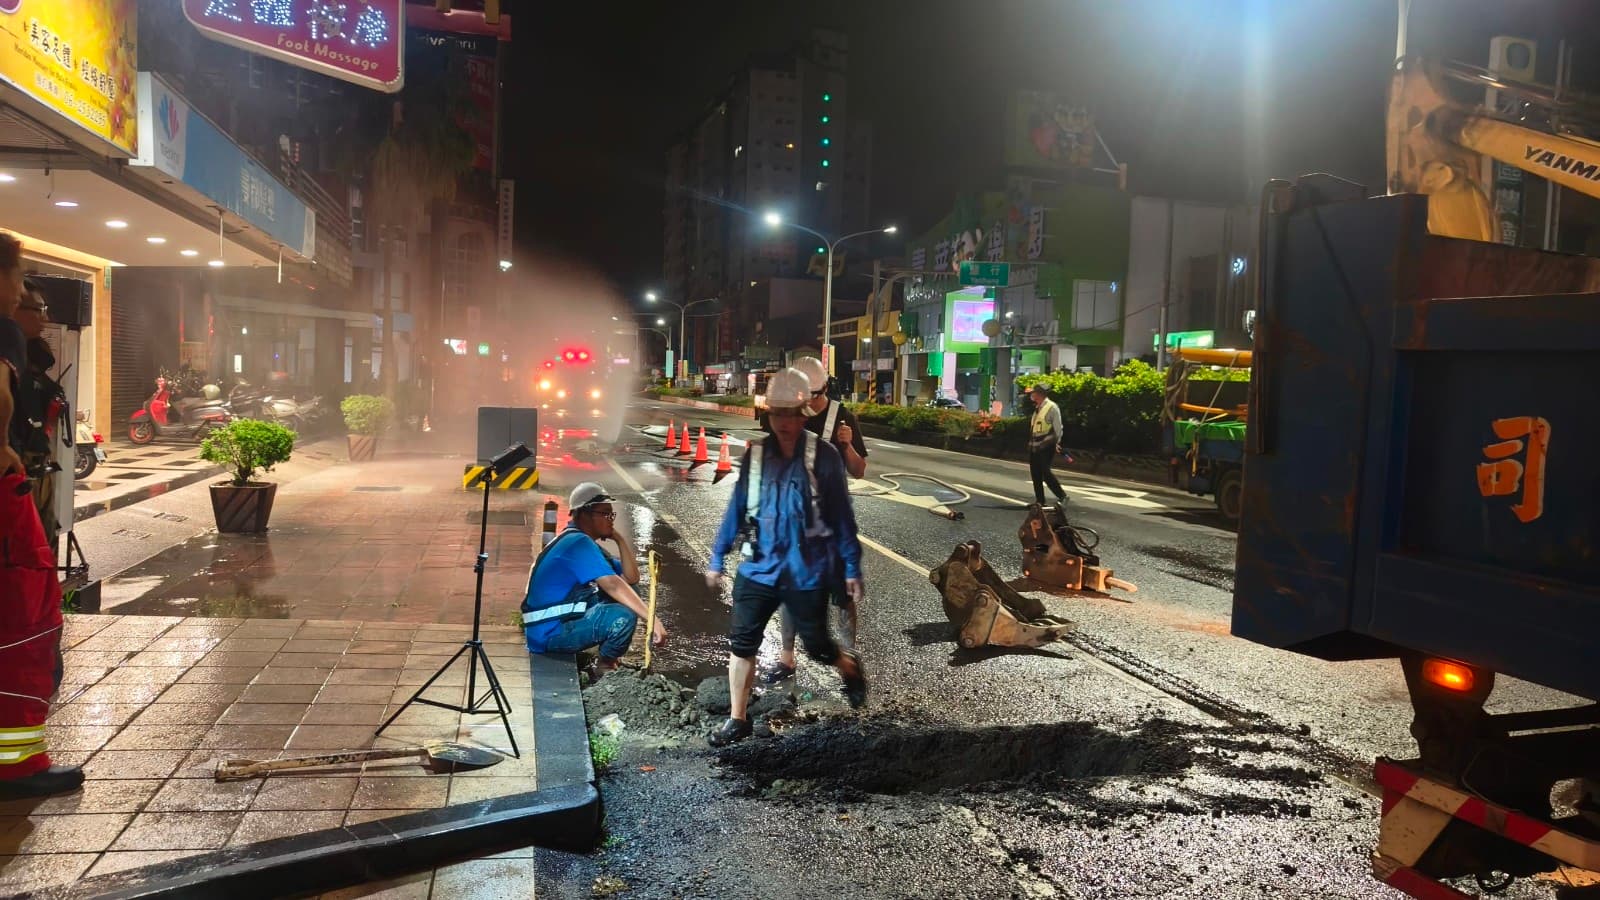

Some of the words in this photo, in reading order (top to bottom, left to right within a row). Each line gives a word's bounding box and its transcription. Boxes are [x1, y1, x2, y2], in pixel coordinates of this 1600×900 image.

[277, 33, 310, 53] Foot
[314, 42, 379, 71] Massage
[1525, 145, 1600, 181] YANM
[1477, 416, 1552, 523] 司
